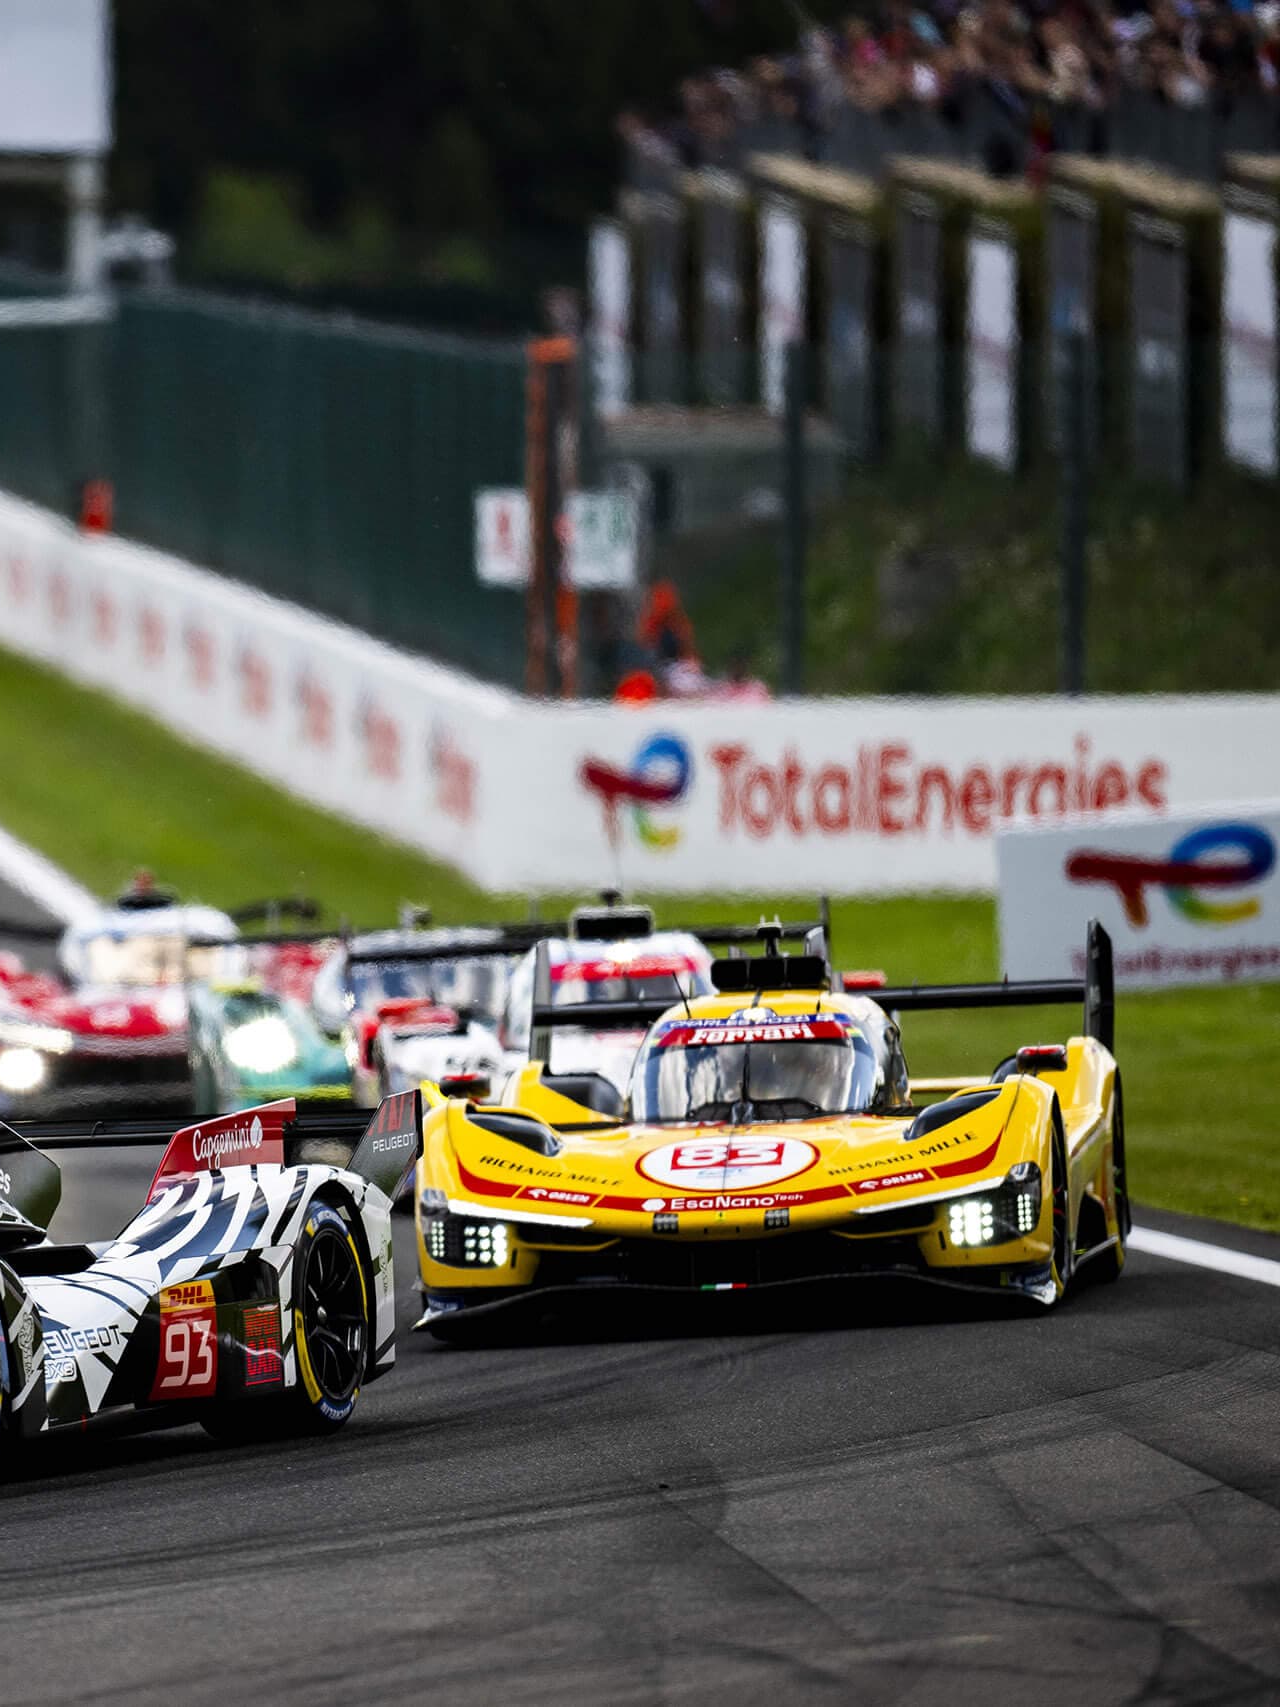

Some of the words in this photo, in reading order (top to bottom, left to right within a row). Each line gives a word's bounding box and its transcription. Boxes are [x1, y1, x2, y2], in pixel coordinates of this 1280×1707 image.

[688, 1024, 815, 1045] Ferrari
[193, 1120, 251, 1169] Capgemini
[372, 1132, 415, 1153] PEUGEOT
[828, 1153, 914, 1177] RICHARD
[919, 1130, 977, 1156] MILLE
[674, 1143, 783, 1168] 83
[480, 1155, 563, 1179] RICHARD
[568, 1173, 624, 1186] MILLE
[880, 1171, 925, 1187] ORLEN
[548, 1190, 590, 1203] ORLEN
[168, 1285, 208, 1307] DHL
[160, 1320, 213, 1387] 93
